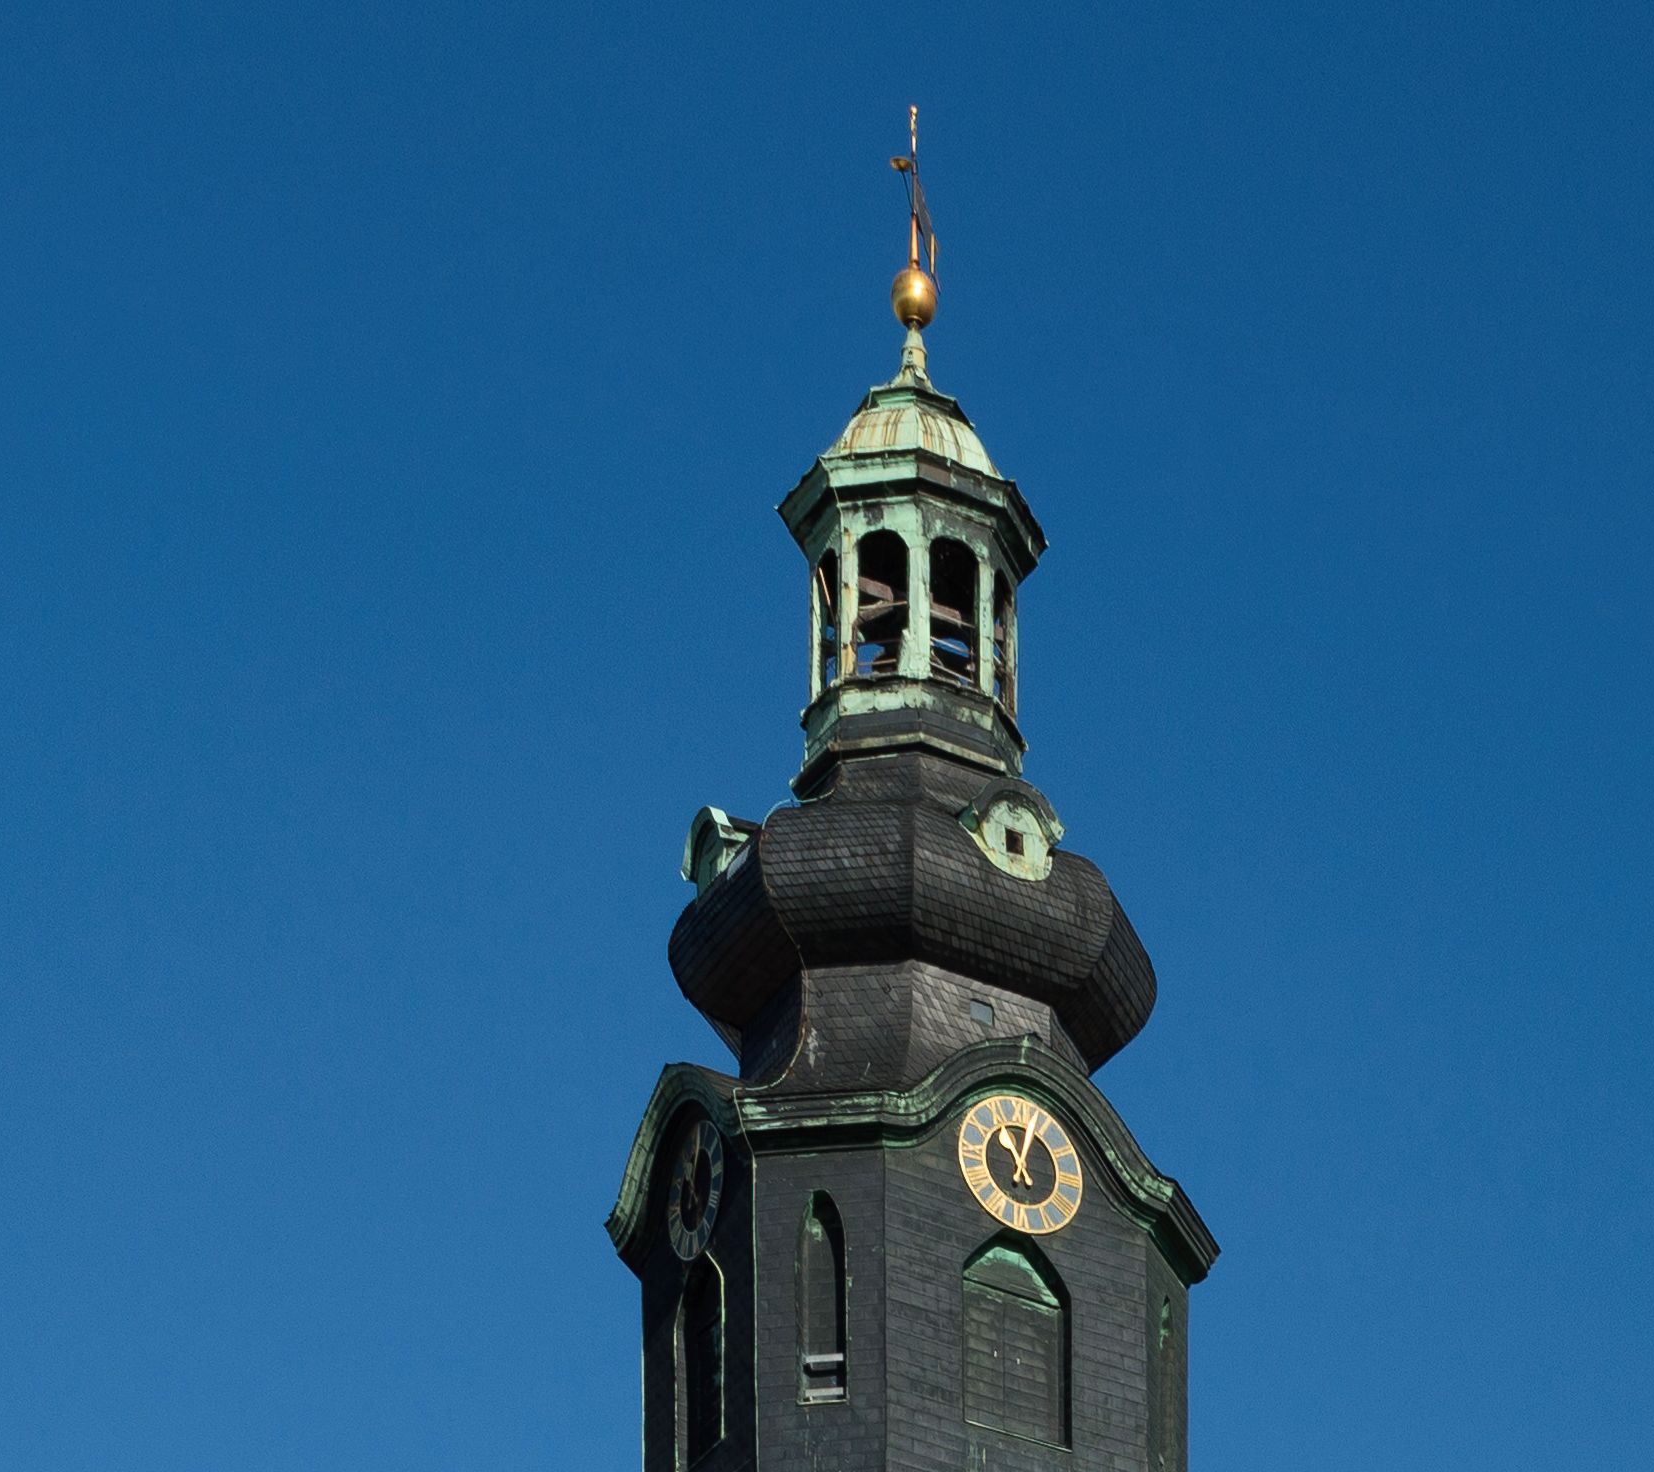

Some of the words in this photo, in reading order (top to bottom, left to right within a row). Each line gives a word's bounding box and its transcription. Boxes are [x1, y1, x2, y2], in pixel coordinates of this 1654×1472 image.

[986, 1100, 1006, 1125] XI
[1012, 1100, 1031, 1126] XII
[966, 1115, 990, 1134] X
[1039, 1117, 1052, 1136] I
[962, 1140, 982, 1161] IX
[1052, 1146, 1072, 1158] II
[1059, 1171, 1080, 1189] III
[1051, 1193, 1074, 1217] IIII
[1013, 1204, 1030, 1230] VI
[1040, 1205, 1055, 1229] V
